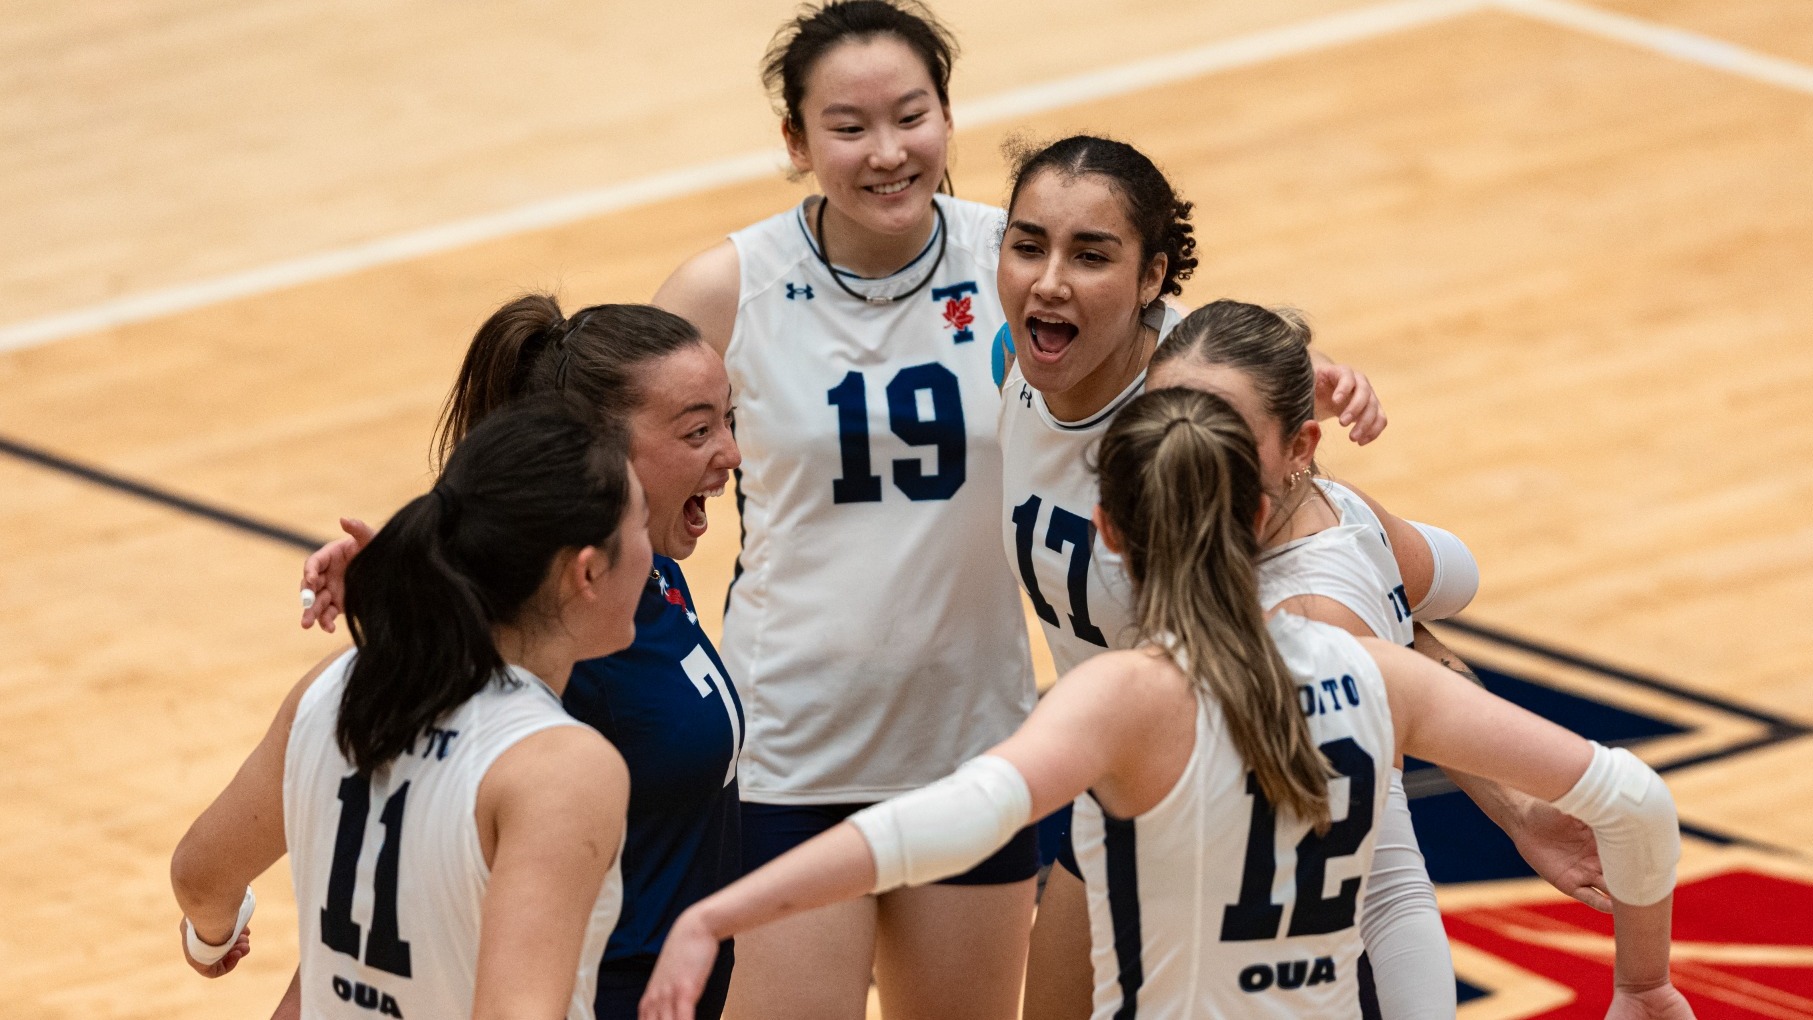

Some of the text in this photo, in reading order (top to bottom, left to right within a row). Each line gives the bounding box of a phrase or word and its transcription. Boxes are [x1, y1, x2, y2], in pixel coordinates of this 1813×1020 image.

[827, 362, 967, 504] 19
[1012, 494, 1109, 649] 17
[680, 643, 741, 789] 7
[321, 771, 413, 979] 11
[1220, 737, 1376, 942] 12
[332, 974, 404, 1019] OUA
[1238, 956, 1336, 992] OUA
